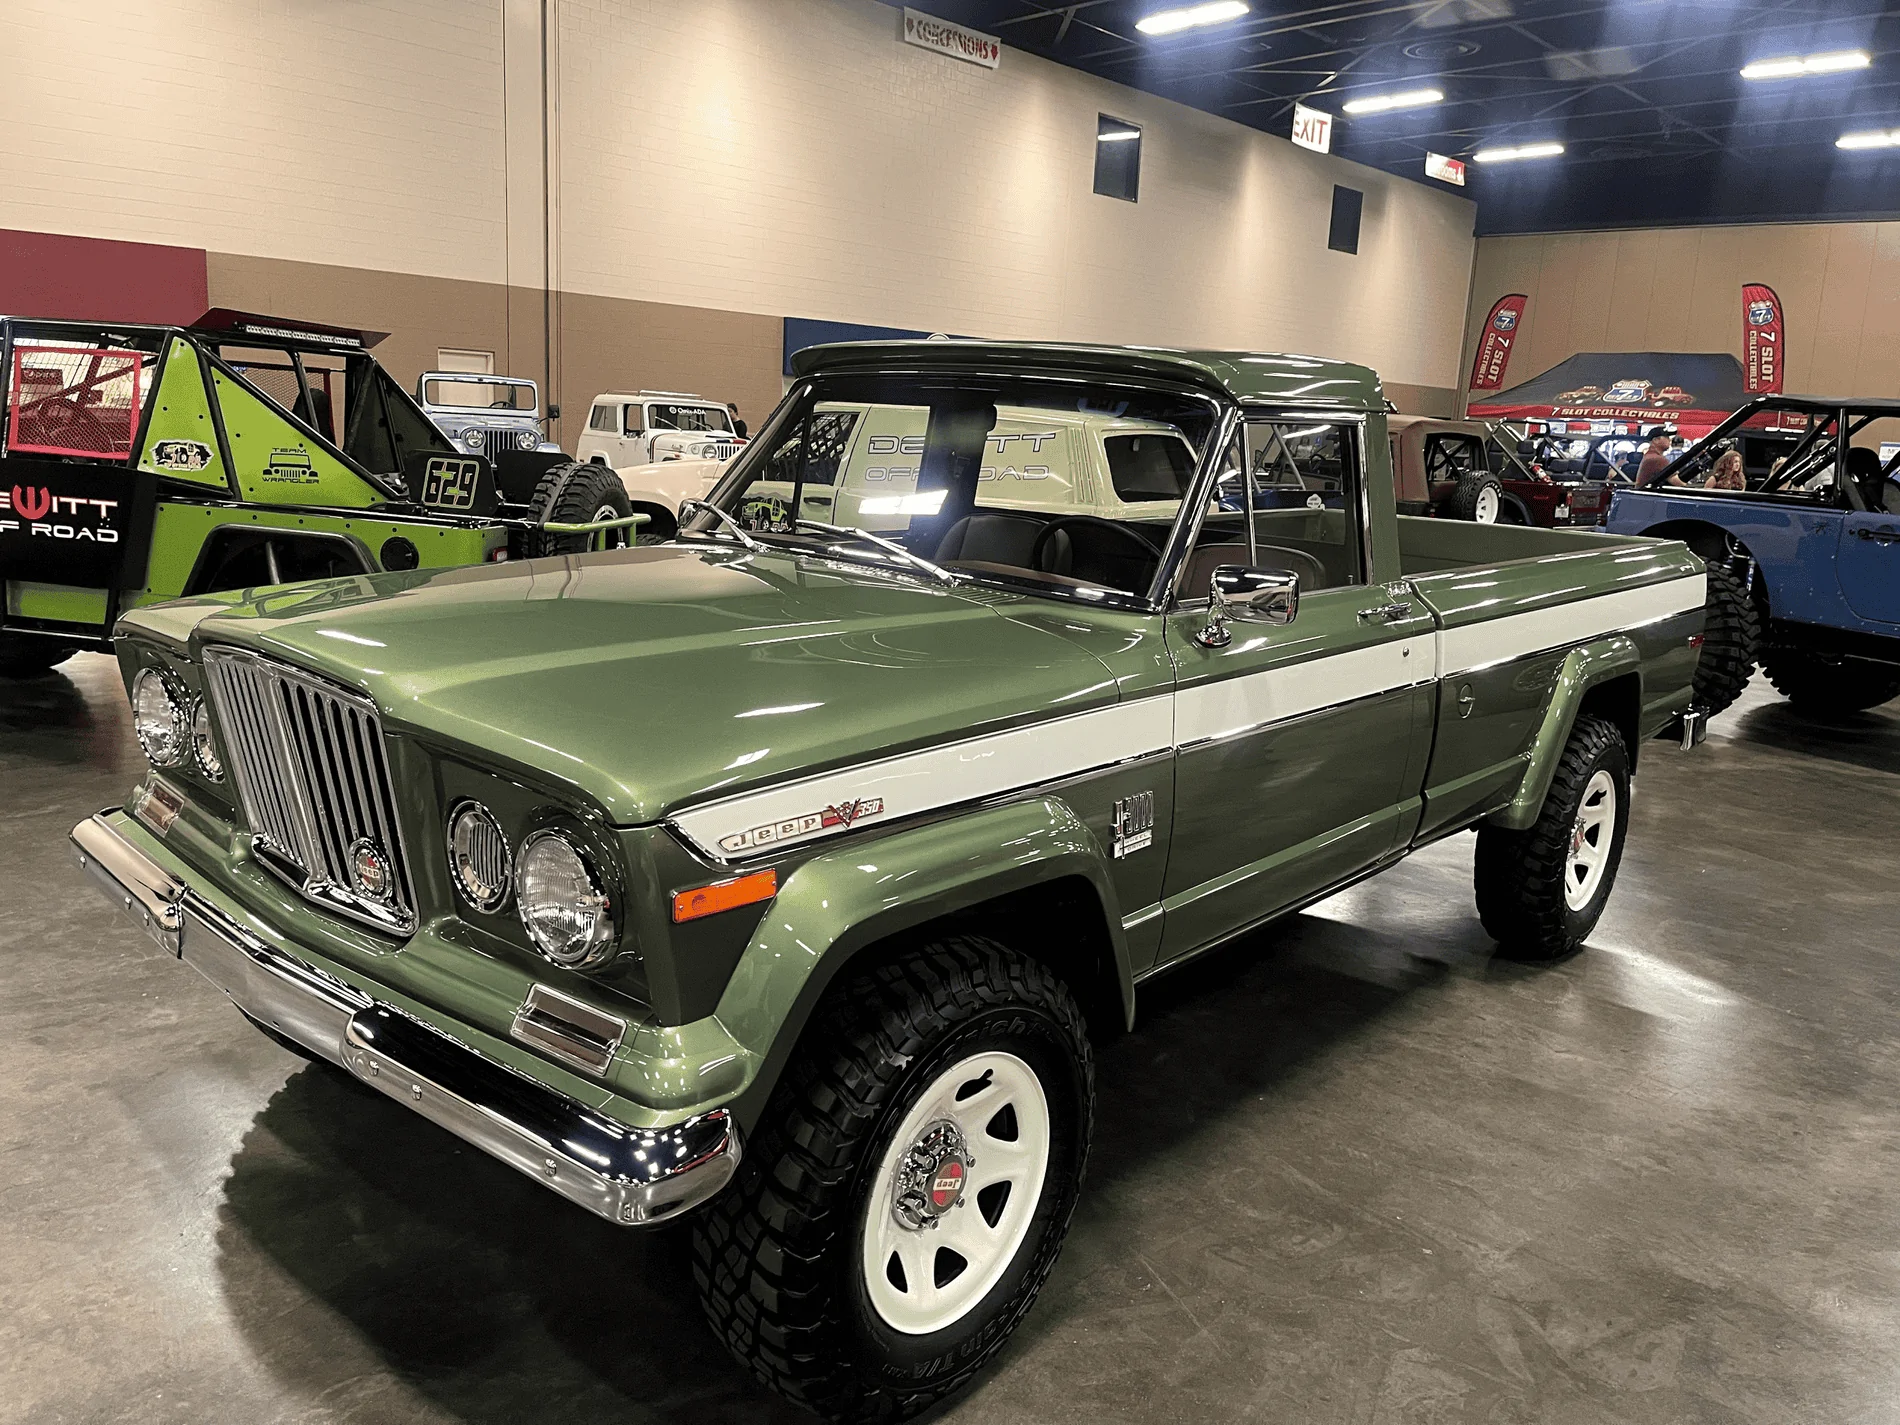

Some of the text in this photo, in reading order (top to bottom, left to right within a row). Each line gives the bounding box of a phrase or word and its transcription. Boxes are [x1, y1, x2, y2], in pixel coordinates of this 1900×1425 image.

[917, 20, 988, 59] CONCESSIONS
[1294, 117, 1328, 145] EXIT
[1498, 336, 1510, 348] 7
[1760, 331, 1775, 342] 7
[1477, 332, 1496, 385] COLLECTIBLES
[1488, 349, 1504, 382] SLOT
[1749, 330, 1758, 390] COLLECTIBLES
[1761, 346, 1774, 383] SLOT
[1551, 407, 1680, 420] 7 SLOT COLLECTIBLES
[867, 433, 1056, 455] DETT
[421, 457, 480, 510] 629
[31, 522, 119, 543] ROAD
[733, 818, 816, 847] Jeep
[857, 799, 881, 817] 350
[936, 1179, 960, 1189] Jeep
